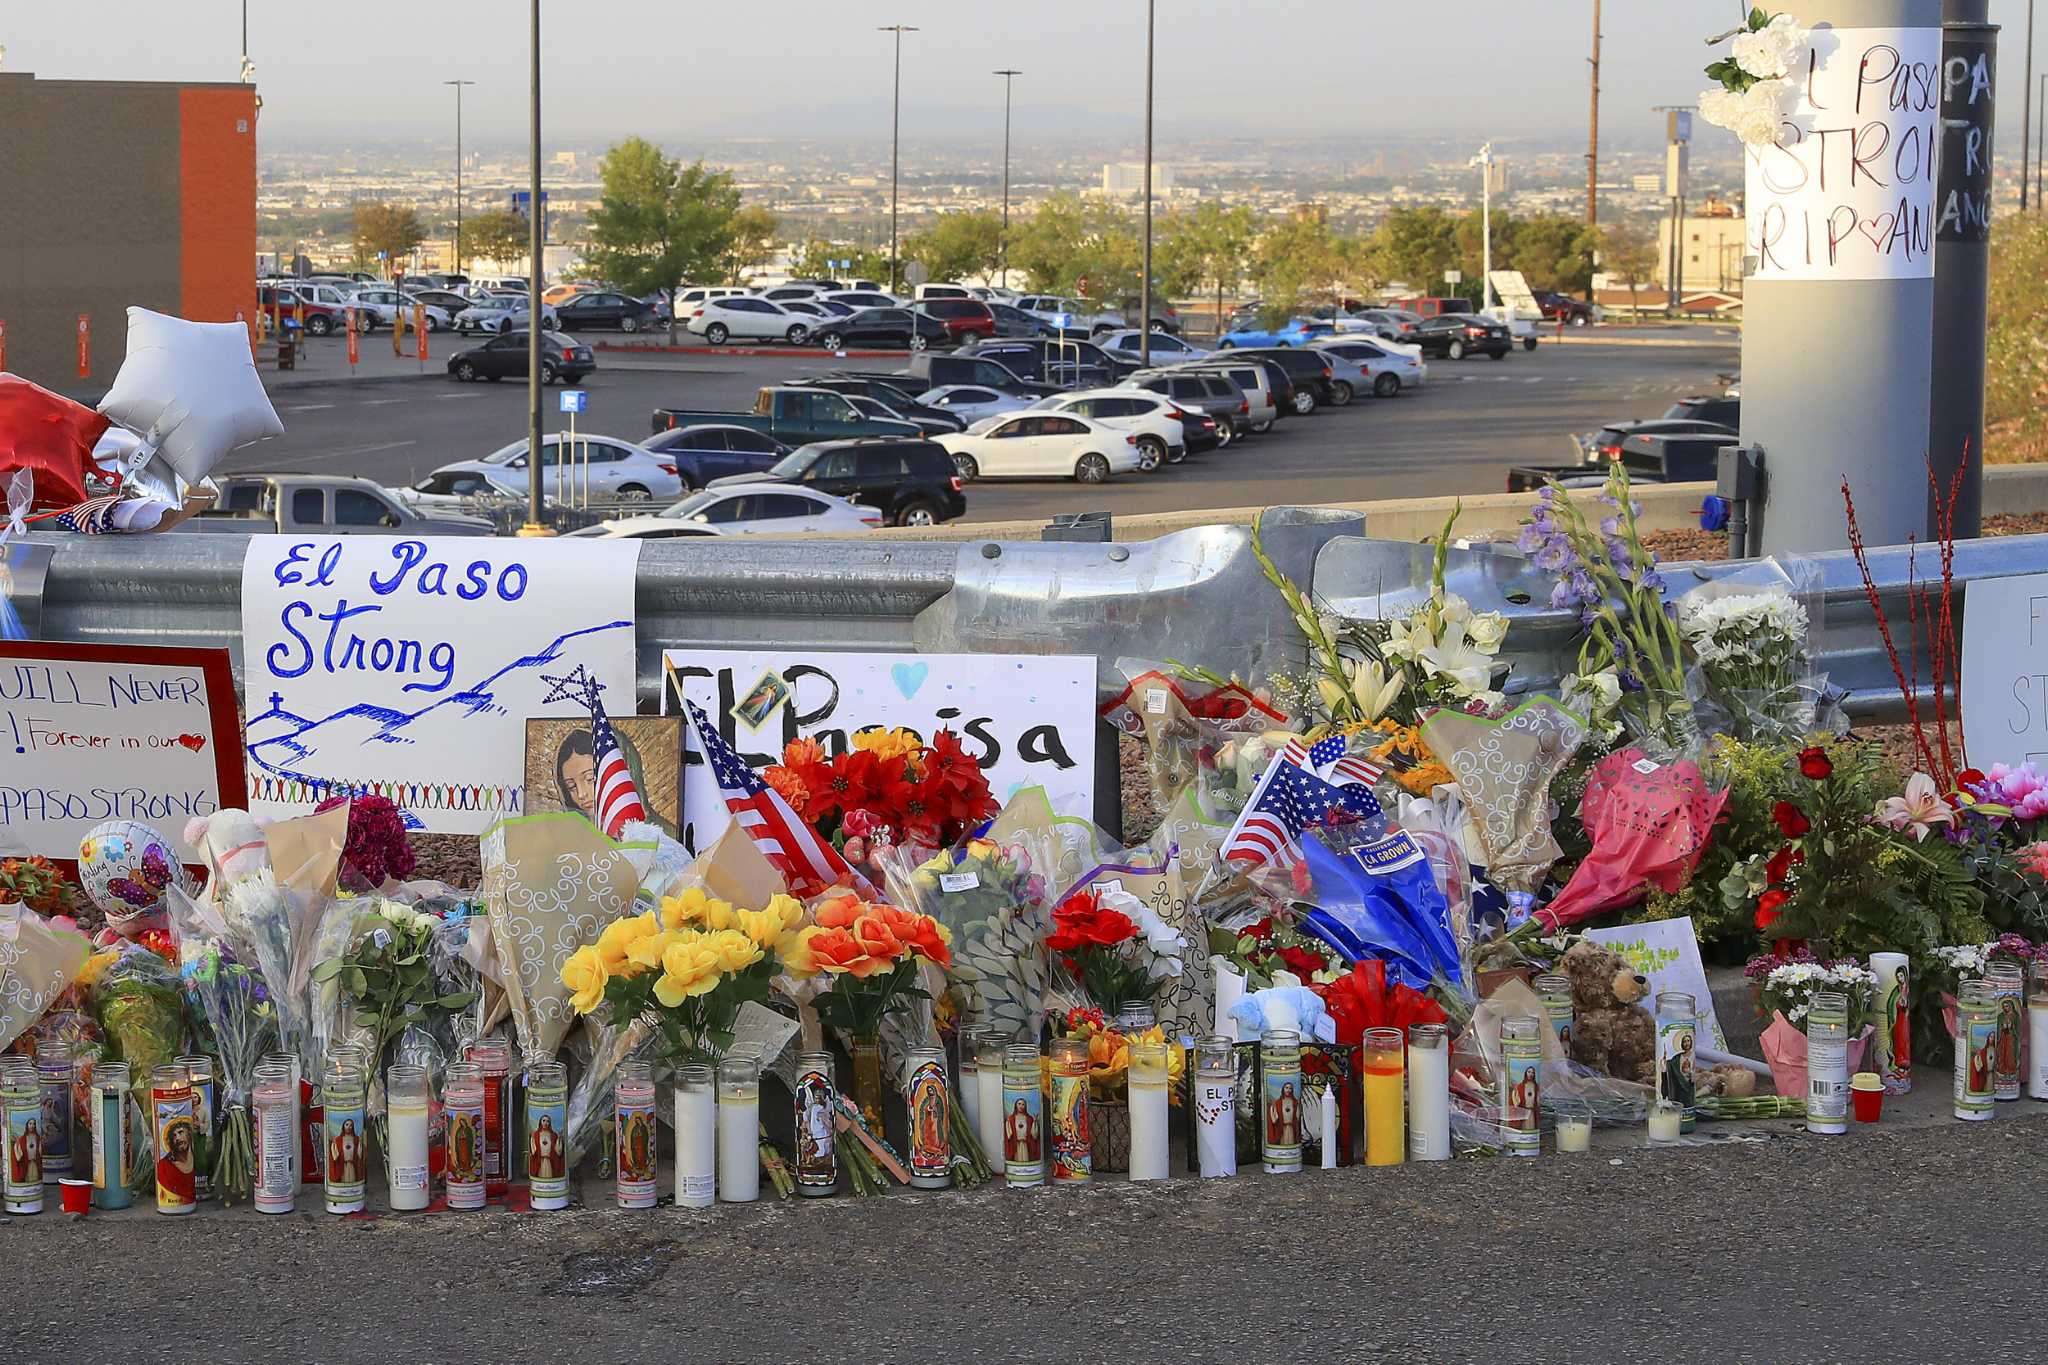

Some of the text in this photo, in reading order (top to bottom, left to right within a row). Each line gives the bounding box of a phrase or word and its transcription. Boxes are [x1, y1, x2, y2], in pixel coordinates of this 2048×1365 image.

[1886, 197, 1936, 263] AN
[274, 541, 529, 601] El Paso
[266, 599, 456, 692] Strong
[108, 674, 204, 708] NEVER
[782, 664, 925, 762] Pa
[119, 734, 140, 748] in
[148, 735, 181, 748] our
[1376, 841, 1411, 862] GROWN
[1206, 1087, 1236, 1099] EL P
